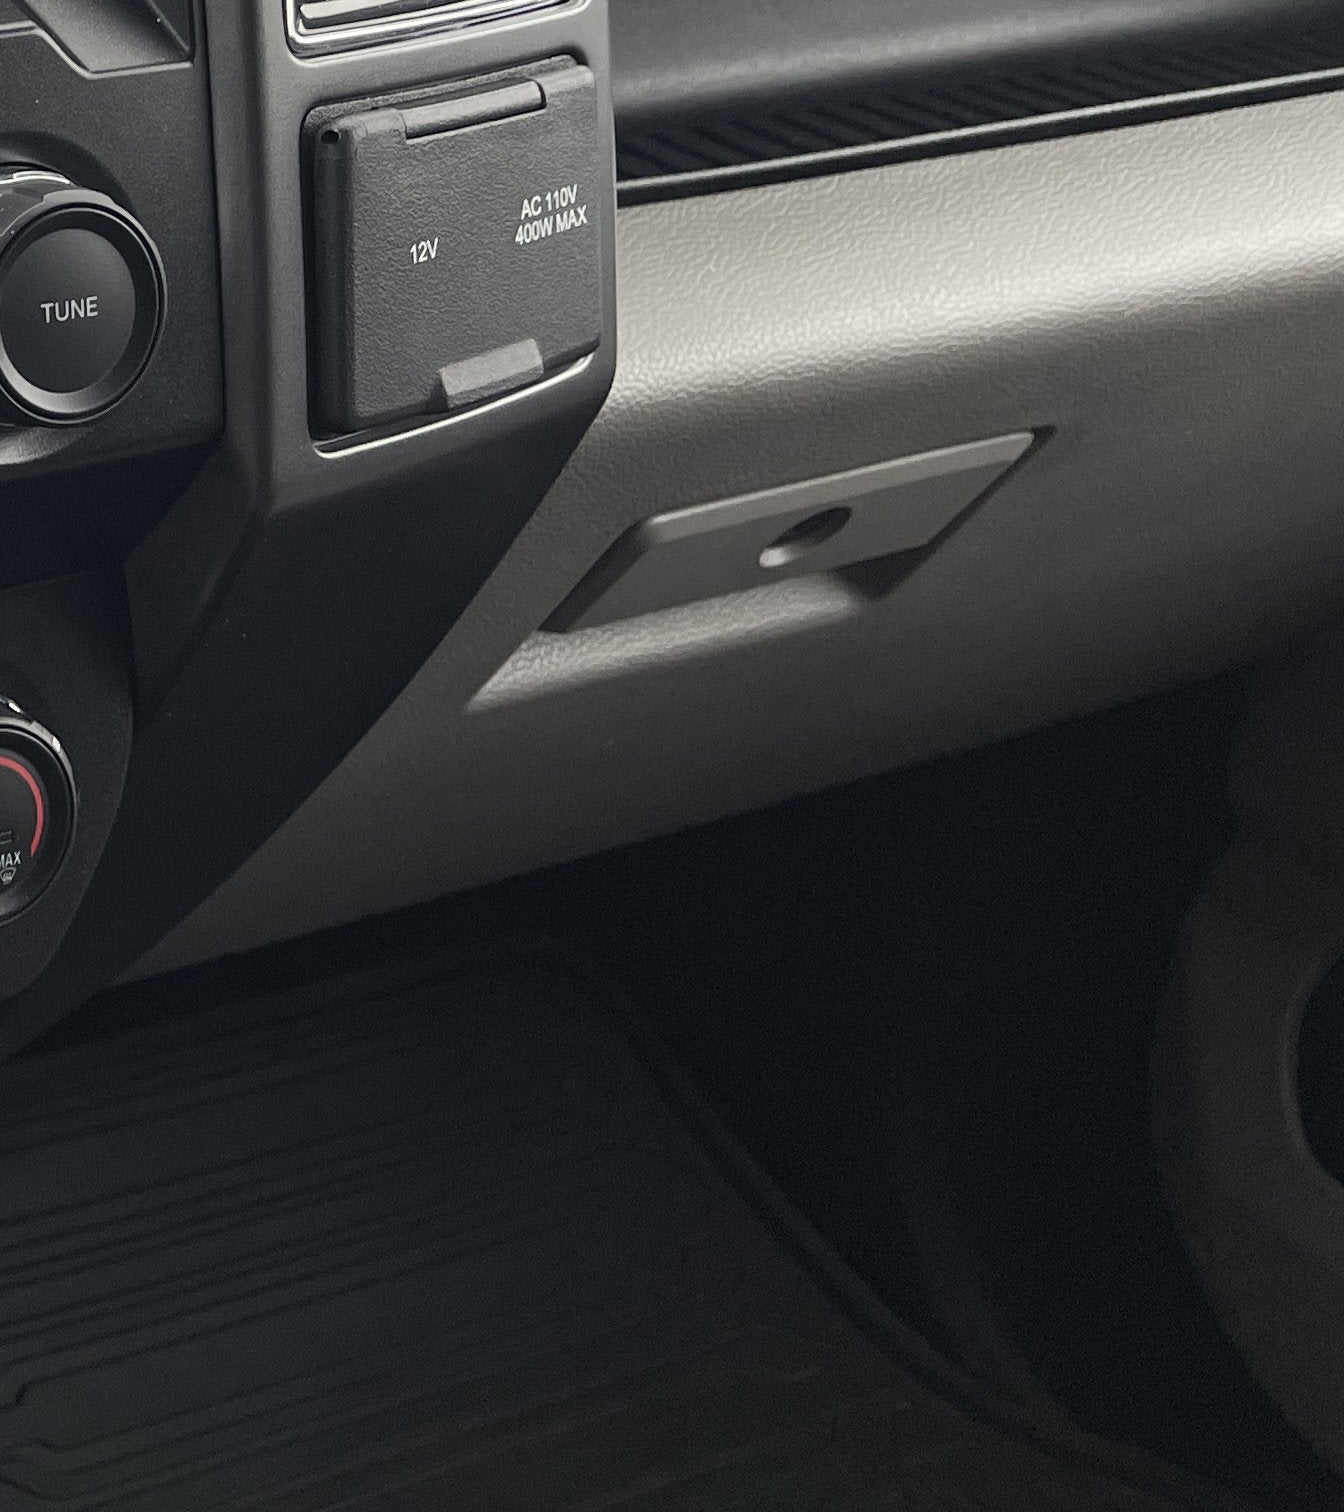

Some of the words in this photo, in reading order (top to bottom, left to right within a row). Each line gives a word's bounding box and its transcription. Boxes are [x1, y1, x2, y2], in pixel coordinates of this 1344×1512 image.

[520, 194, 543, 221] AC
[544, 183, 578, 212] 110V
[514, 215, 554, 245] 400W
[555, 204, 588, 233] MAX
[409, 237, 439, 265] 12V
[40, 295, 99, 323] TUNE
